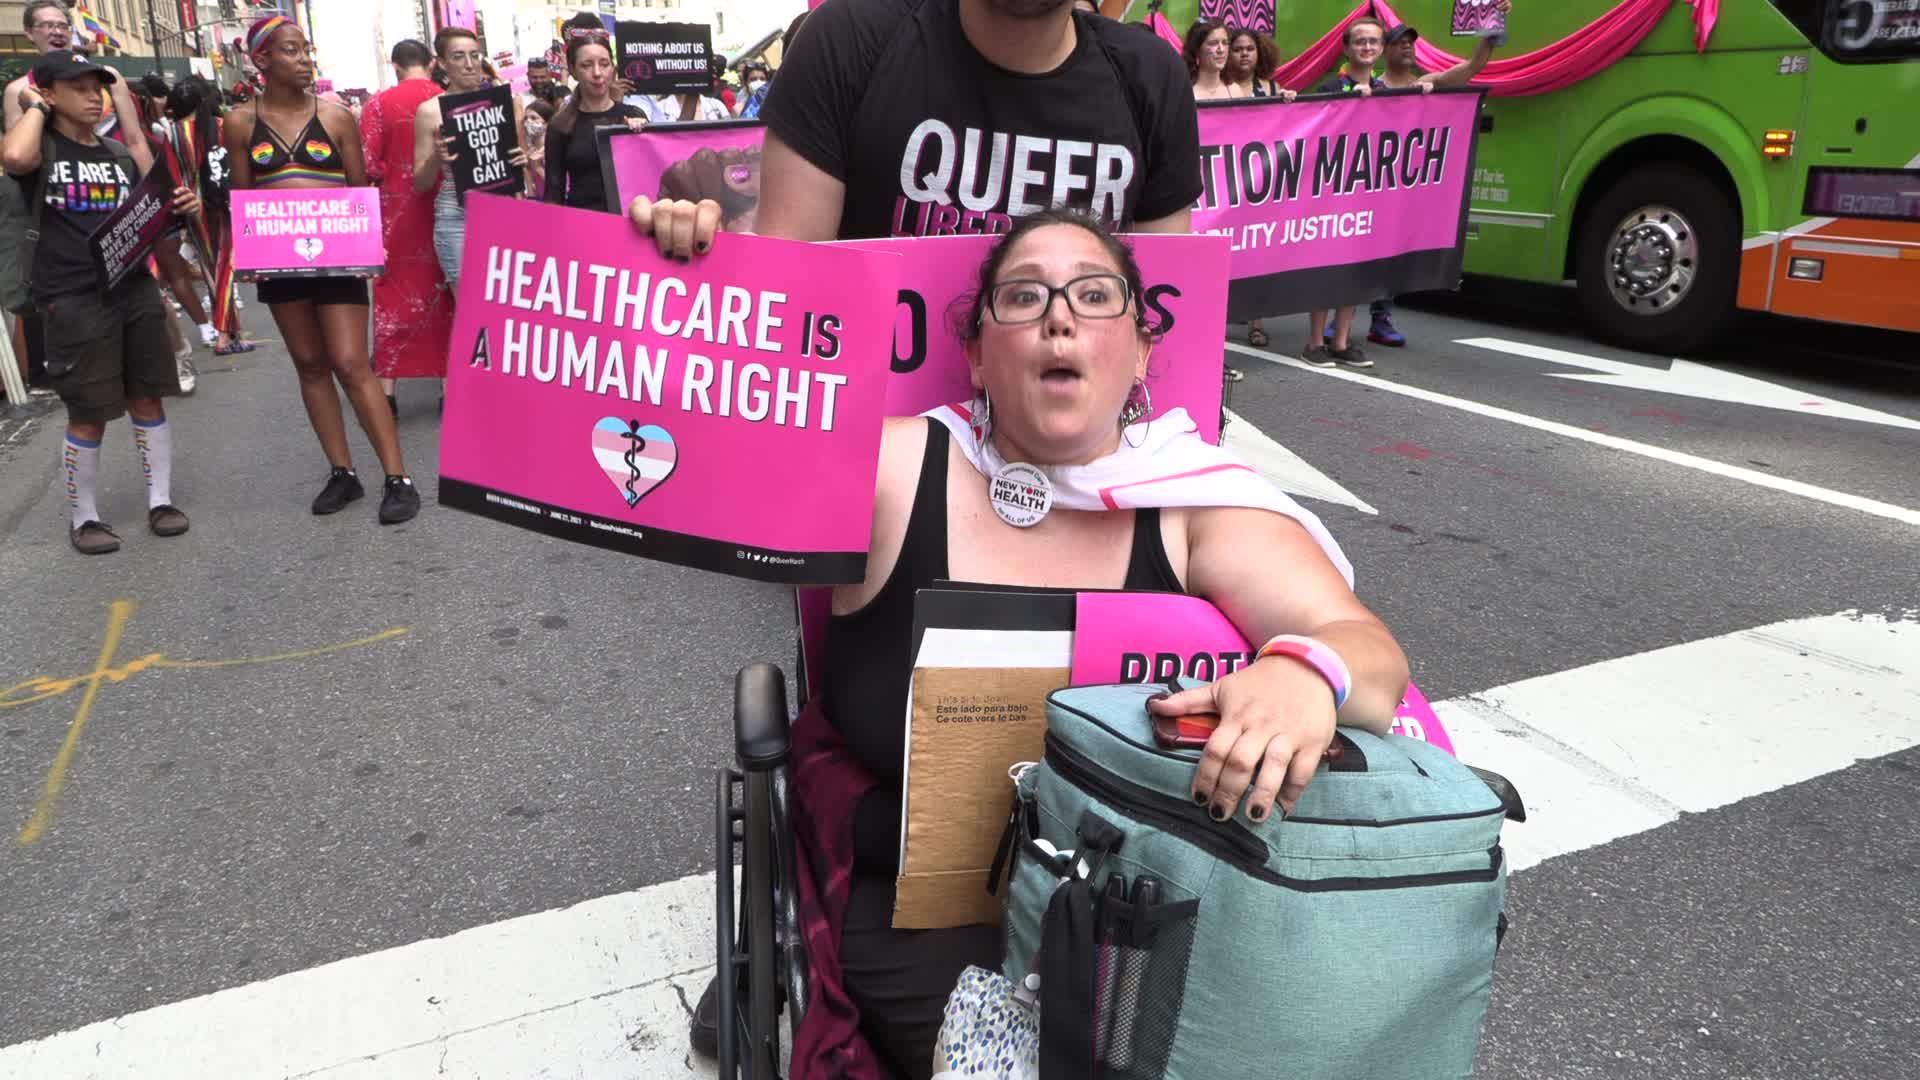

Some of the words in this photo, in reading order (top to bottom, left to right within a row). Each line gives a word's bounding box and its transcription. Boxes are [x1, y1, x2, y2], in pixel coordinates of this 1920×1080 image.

[625, 42, 662, 55] NOTHING
[664, 42, 692, 54] ABOUT
[693, 42, 704, 54] US
[655, 59, 692, 71] WITHOUT
[453, 105, 506, 132] THANK
[467, 126, 499, 148] GOD
[476, 144, 498, 166] I'M
[78, 161, 116, 184] ARE
[114, 163, 130, 184] A
[472, 160, 507, 184] GAY!
[900, 118, 1135, 225] QUEER
[1191, 138, 1306, 211] TION
[1312, 127, 1450, 199] MARCH
[245, 200, 350, 218] HEALTHCARE
[354, 203, 367, 215] IS
[243, 223, 251, 236] A
[256, 218, 318, 236] HUMAN
[321, 216, 369, 235] RIGHT
[1280, 211, 1374, 244] JUSTICE!
[484, 245, 788, 353] HEALTHCARE
[801, 312, 843, 360] IS
[470, 327, 491, 370] A
[501, 320, 669, 406] HUMAN
[681, 353, 848, 432] RIGHT
[996, 479, 1018, 491] NEW
[994, 488, 1045, 511] HEALTH
[936, 705, 958, 714] Este
[960, 704, 982, 713] lado
[984, 705, 1006, 715] para
[1008, 703, 1029, 715] bajo
[936, 714, 950, 723] Ce
